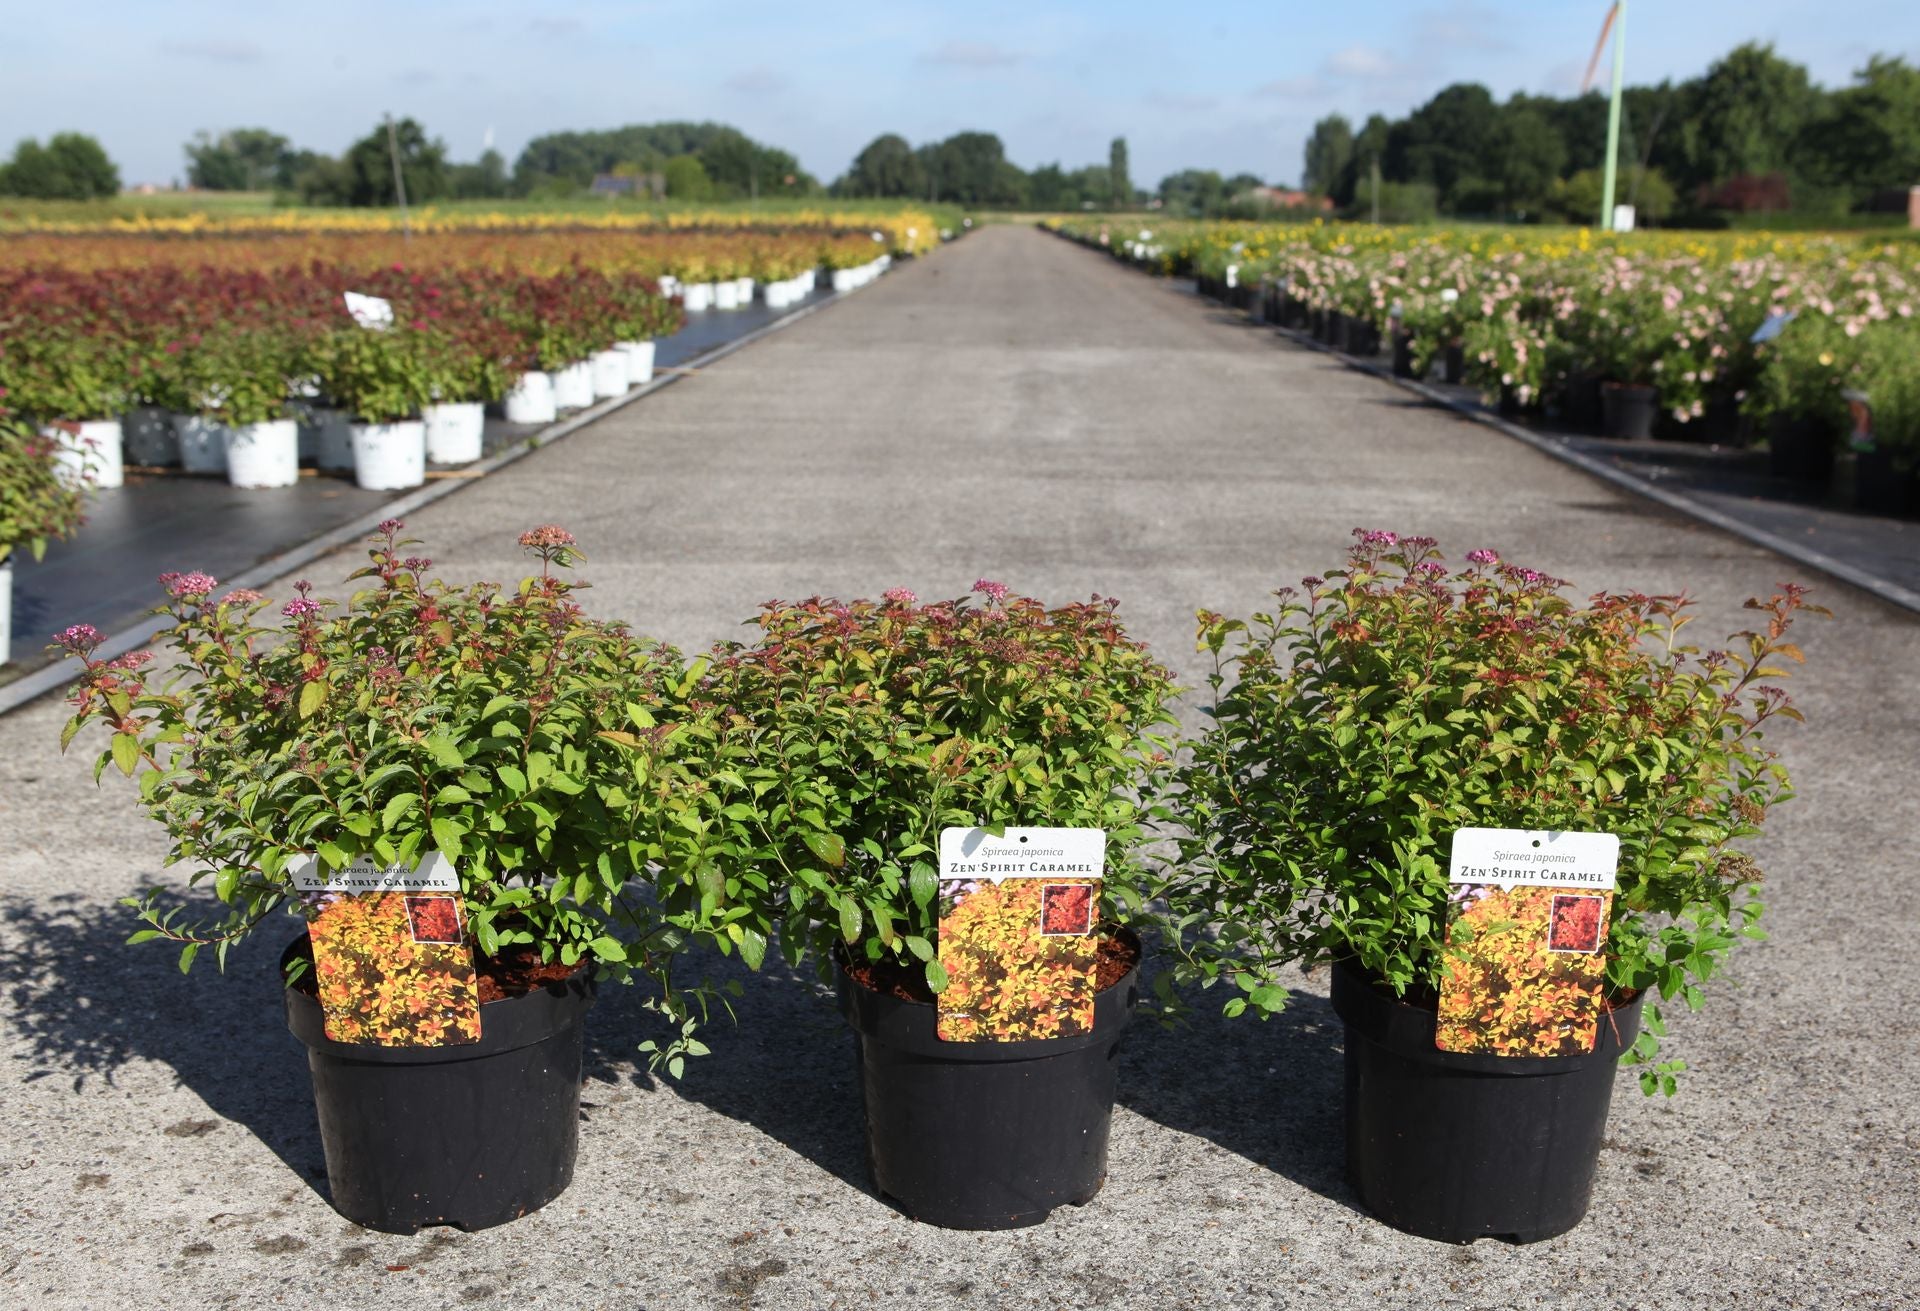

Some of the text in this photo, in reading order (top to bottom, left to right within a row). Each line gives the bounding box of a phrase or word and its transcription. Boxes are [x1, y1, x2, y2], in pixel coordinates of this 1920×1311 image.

[981, 847, 1064, 858] Spiraea japonica
[1492, 850, 1576, 863] Spiraea japonica
[330, 866, 368, 875] Siraea
[1030, 862, 1092, 872] CARAMEL
[1541, 869, 1604, 882] CARAMEL
[384, 878, 448, 887] CARAMEL
